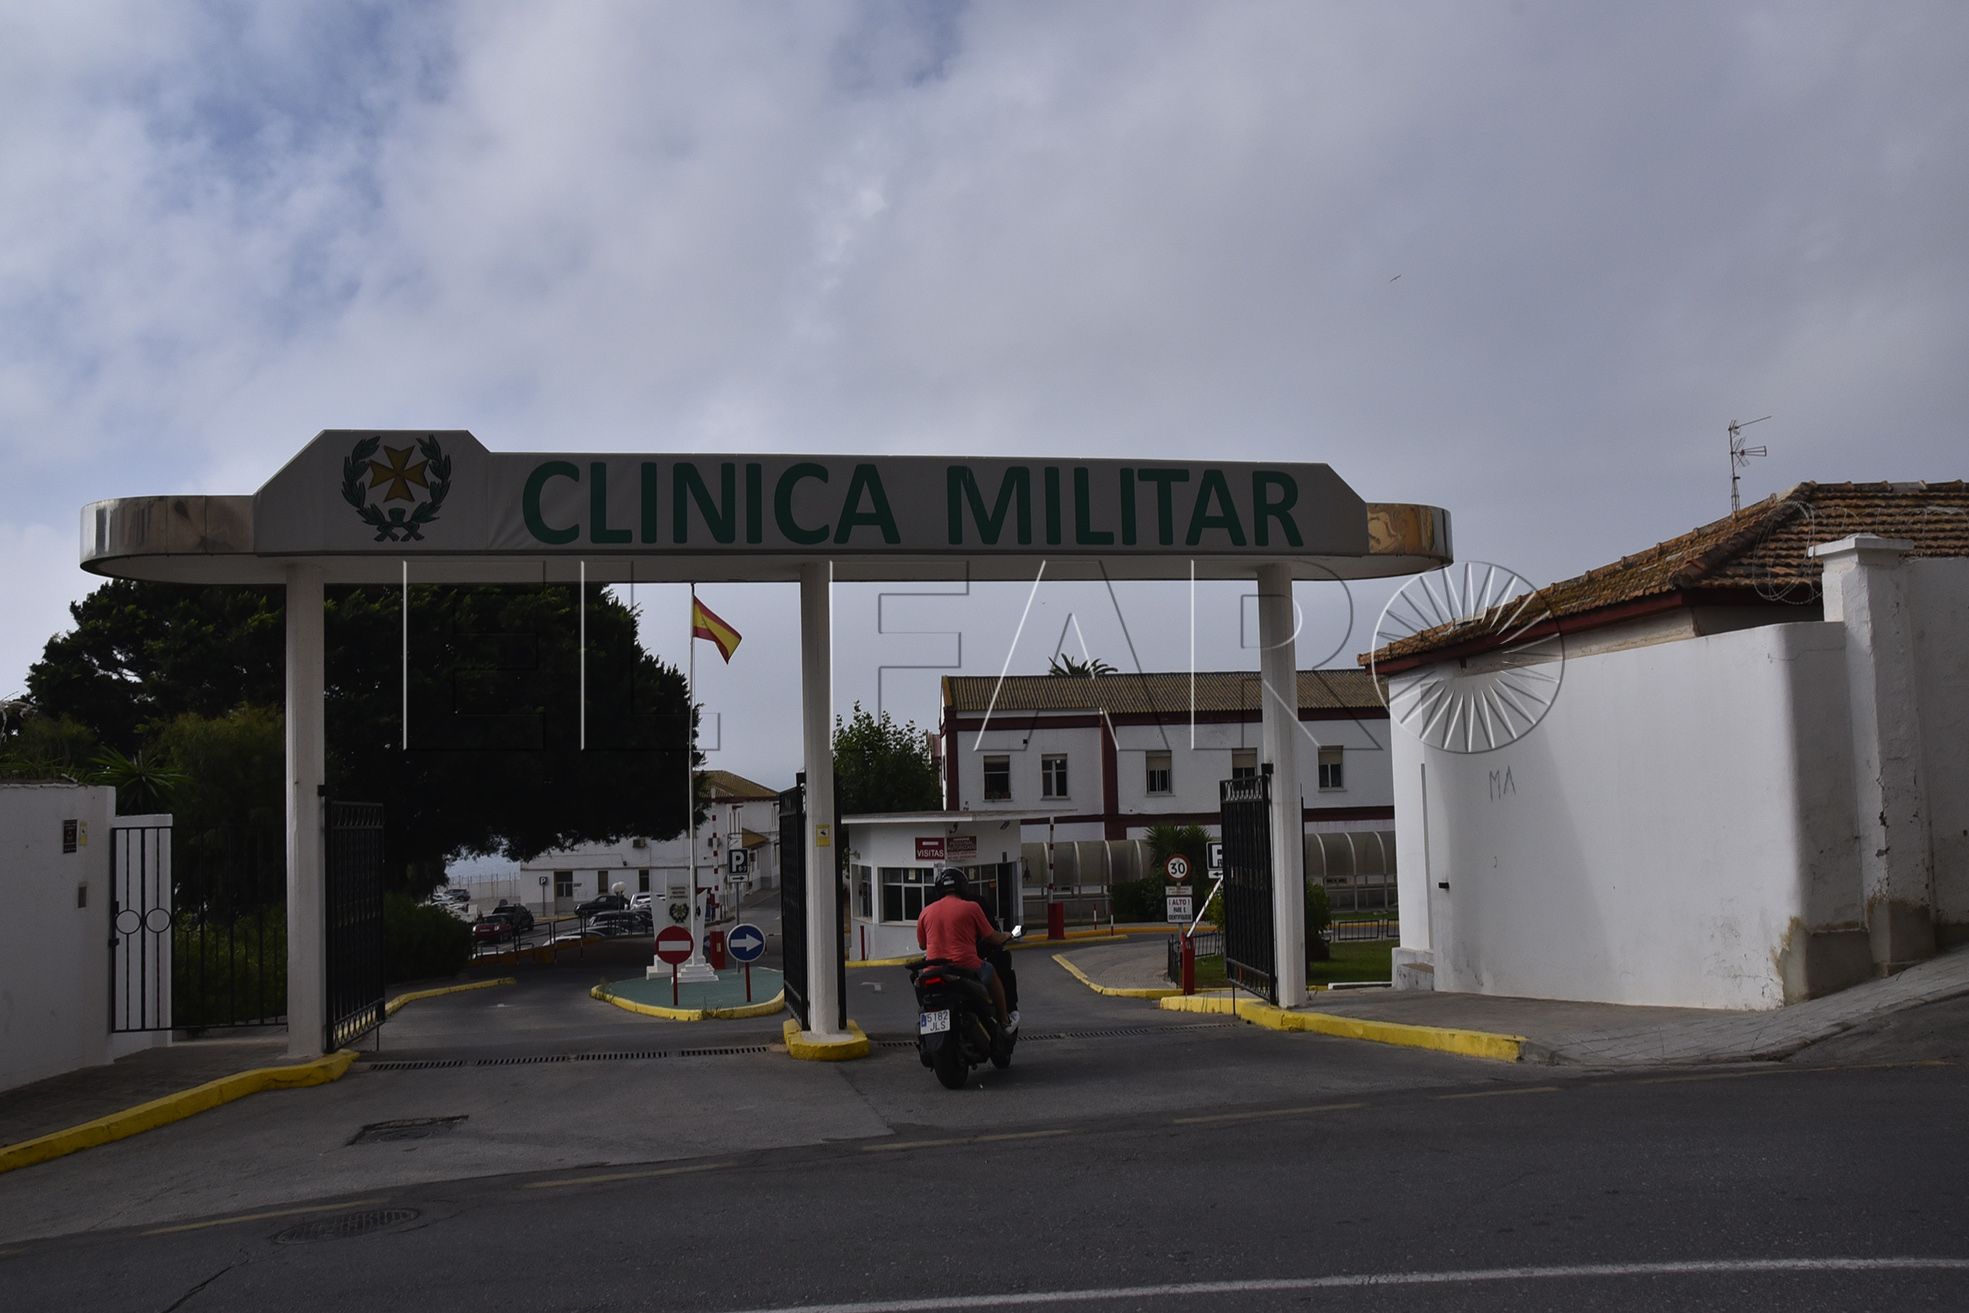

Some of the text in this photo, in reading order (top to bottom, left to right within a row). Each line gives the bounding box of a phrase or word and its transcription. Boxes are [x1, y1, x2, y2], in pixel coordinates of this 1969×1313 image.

[522, 460, 1304, 548] CLINICA MILITAR
[917, 849, 944, 857] VISITAS
[731, 851, 745, 872] P
[1170, 862, 1186, 875] 30
[540, 877, 546, 885] P
[927, 1009, 948, 1023] 5182
[930, 1020, 946, 1031] JLS
